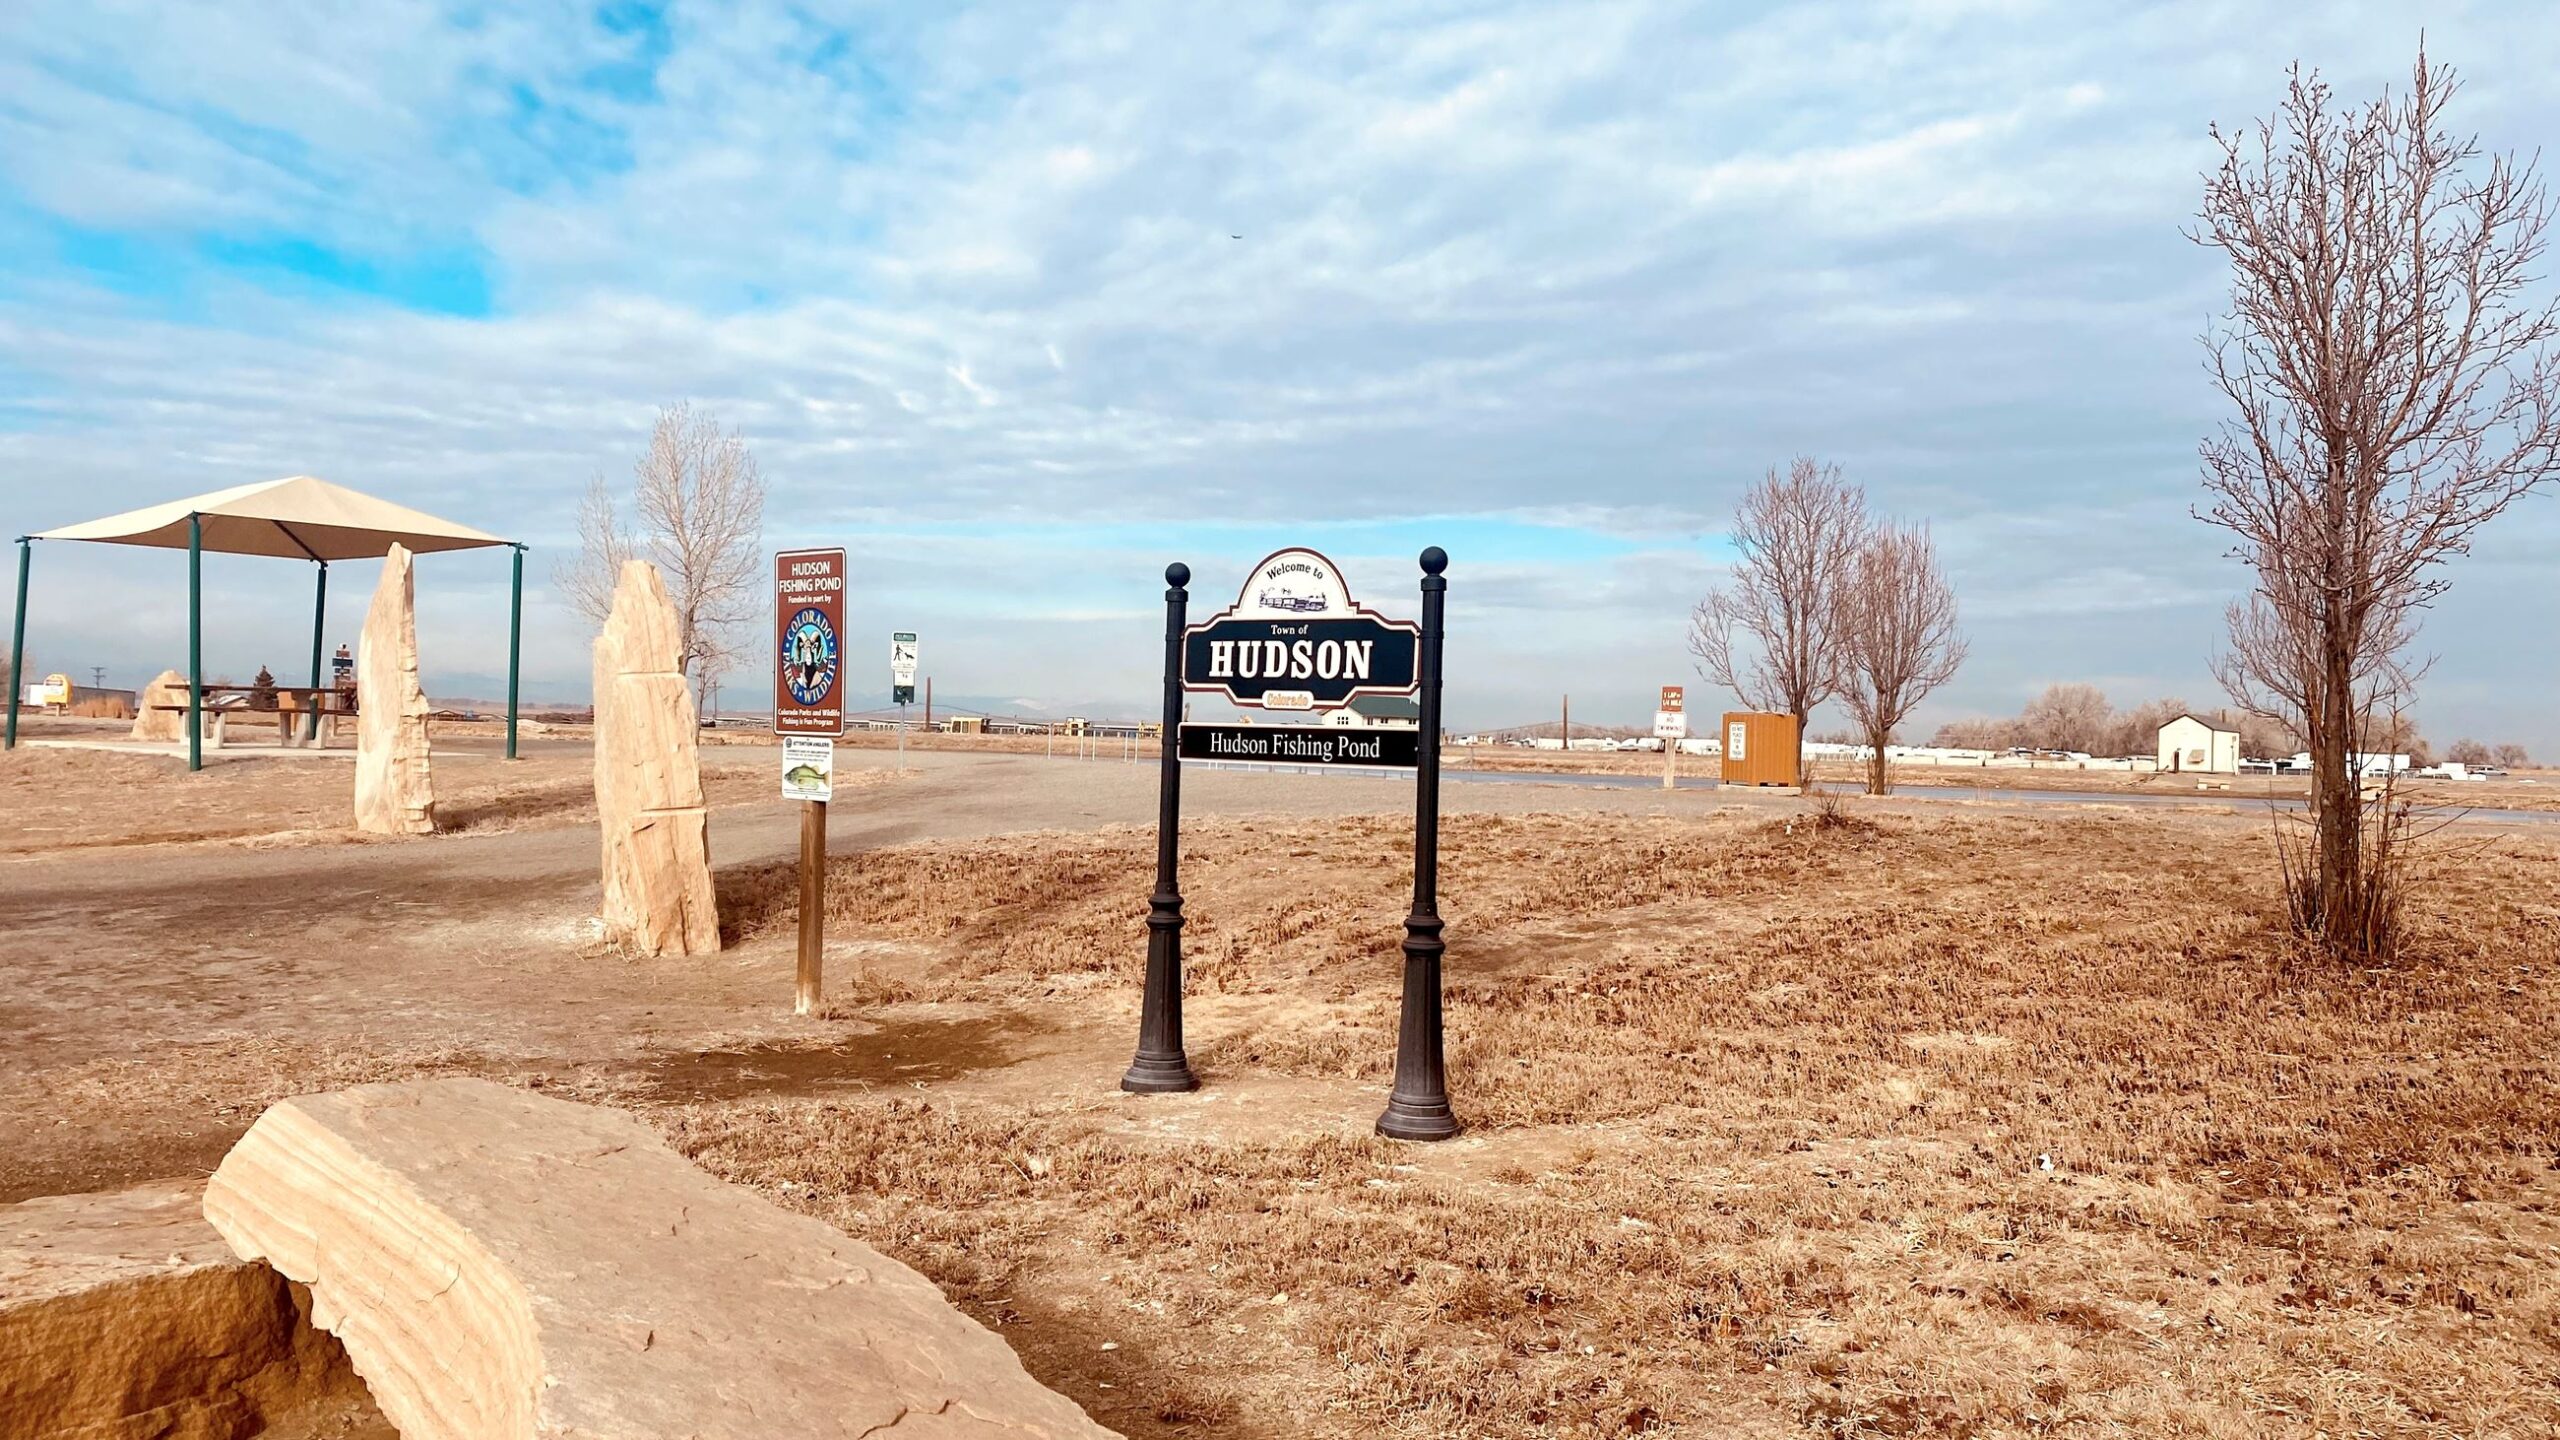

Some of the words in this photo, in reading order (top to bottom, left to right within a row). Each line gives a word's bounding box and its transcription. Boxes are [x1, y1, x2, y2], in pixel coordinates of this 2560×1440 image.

[791, 561, 830, 576] HUDSON
[1266, 563, 1311, 581] Welcome
[1312, 569, 1324, 580] to
[779, 578, 814, 593] FISHING
[814, 577, 842, 591] POND
[788, 595, 807, 604] Funded
[813, 595, 824, 605] part
[824, 594, 832, 604] by
[786, 610, 833, 641] COLORADO
[1270, 625, 1296, 635] Town
[1298, 624, 1309, 635] of
[1208, 640, 1373, 679] HUDSON
[783, 651, 799, 695] PARKS
[804, 650, 837, 703] WILDLIFE
[1266, 693, 1309, 707] Colorado
[778, 708, 798, 716] Colorado
[799, 708, 811, 716] Parks
[822, 708, 840, 717] Wildlife
[782, 717, 799, 727] Fishing
[804, 718, 813, 726] Fun
[813, 718, 834, 728] Program
[1210, 732, 1268, 754] Hudson
[1272, 734, 1333, 762] Fishing
[1337, 736, 1380, 758] Pond
